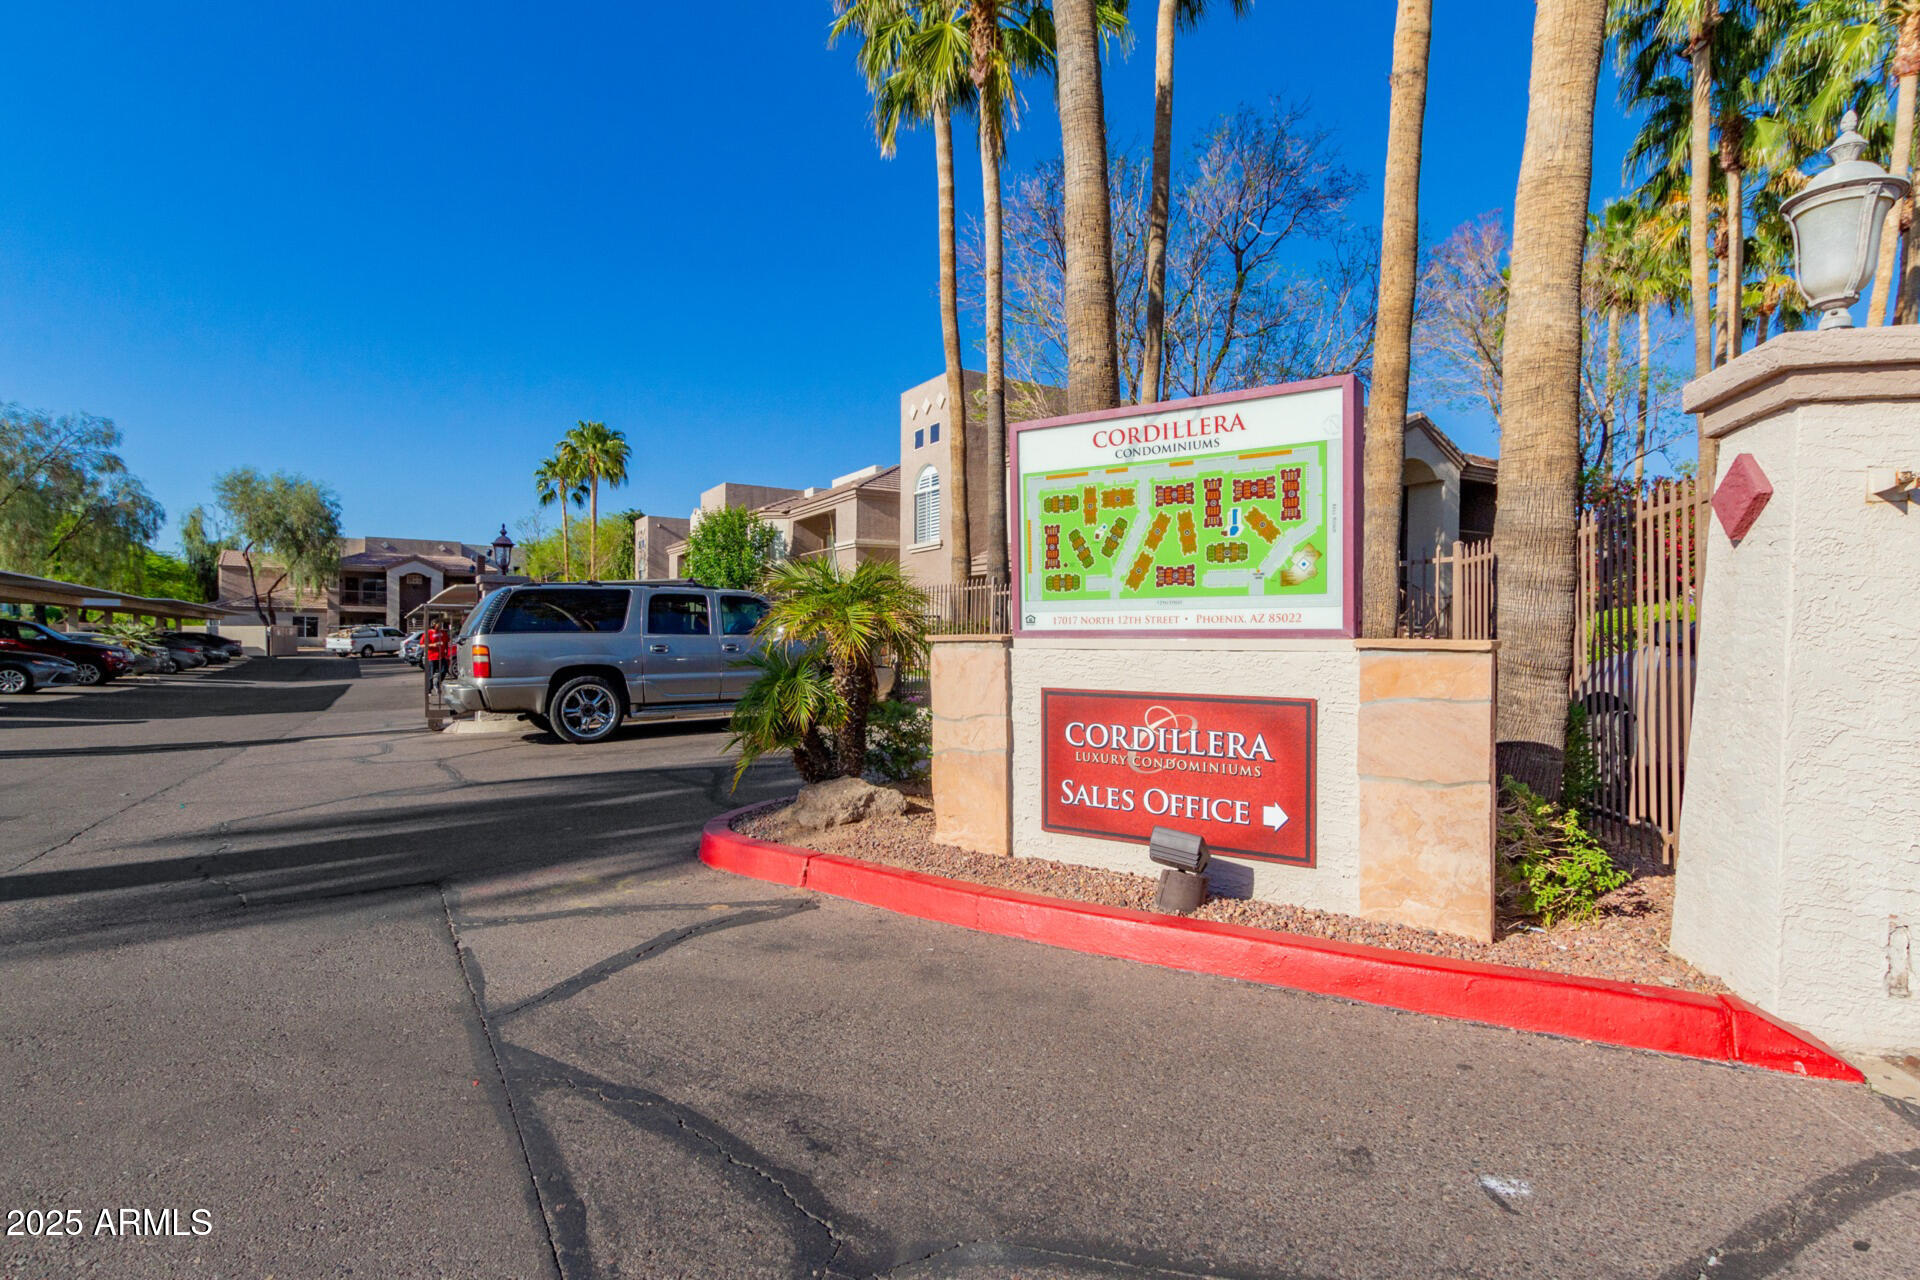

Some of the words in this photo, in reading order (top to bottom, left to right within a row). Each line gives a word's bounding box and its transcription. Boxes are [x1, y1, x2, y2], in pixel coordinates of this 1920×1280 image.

[1093, 413, 1247, 449] CORDILLERA
[1115, 438, 1220, 459] CONDOMINIUMS
[1053, 616, 1078, 625] 17017
[1080, 616, 1114, 625] NORTH
[1117, 615, 1142, 625] 12TH
[1145, 615, 1180, 624] STREET
[1250, 613, 1265, 623] AZ
[1268, 613, 1303, 623] 85022
[1065, 721, 1275, 762] CORDILLERA
[1075, 751, 1128, 766] LUXURY
[1132, 756, 1262, 777] CONDOMINIUMS
[1061, 779, 1135, 812] SALES
[1143, 788, 1250, 825] OFFICE
